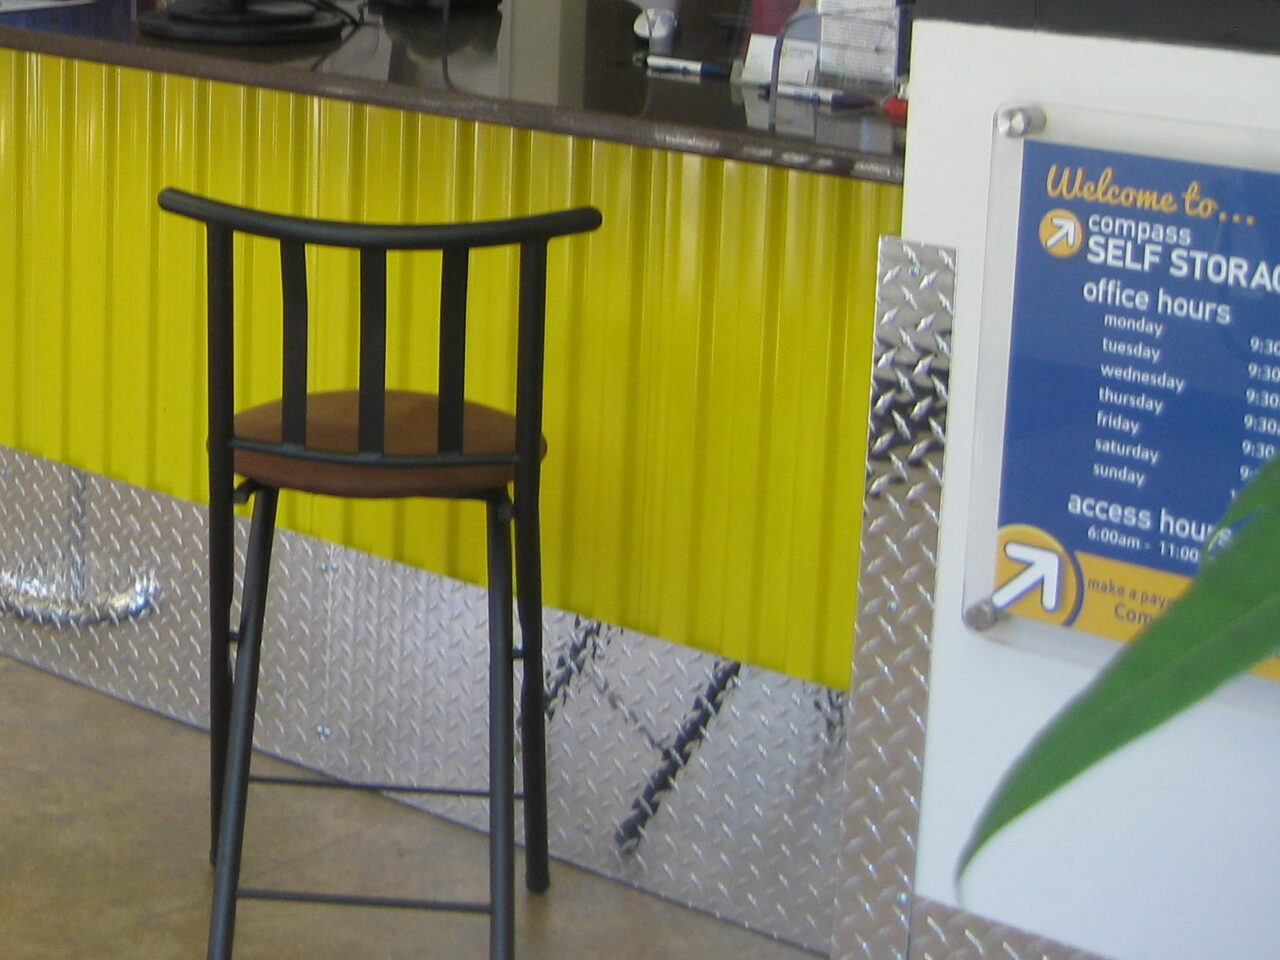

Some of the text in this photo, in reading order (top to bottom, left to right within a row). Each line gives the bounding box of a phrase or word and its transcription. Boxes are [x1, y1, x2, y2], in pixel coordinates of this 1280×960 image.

[1046, 164, 1179, 214] Welcome
[1088, 213, 1192, 247] compass
[1086, 235, 1163, 272] SELF
[1083, 277, 1232, 325] office hours
[1104, 314, 1164, 338] monday
[1102, 337, 1161, 364] tuesday
[1100, 363, 1186, 394] wednesday
[1098, 387, 1164, 415] thursday
[1096, 410, 1140, 436] friday
[1094, 438, 1160, 466] saturday
[1092, 463, 1146, 488] sunday
[1068, 493, 1152, 530] access
[1087, 525, 1140, 550] 6:00am
[1087, 578, 1125, 597] make
[1129, 587, 1136, 600] a
